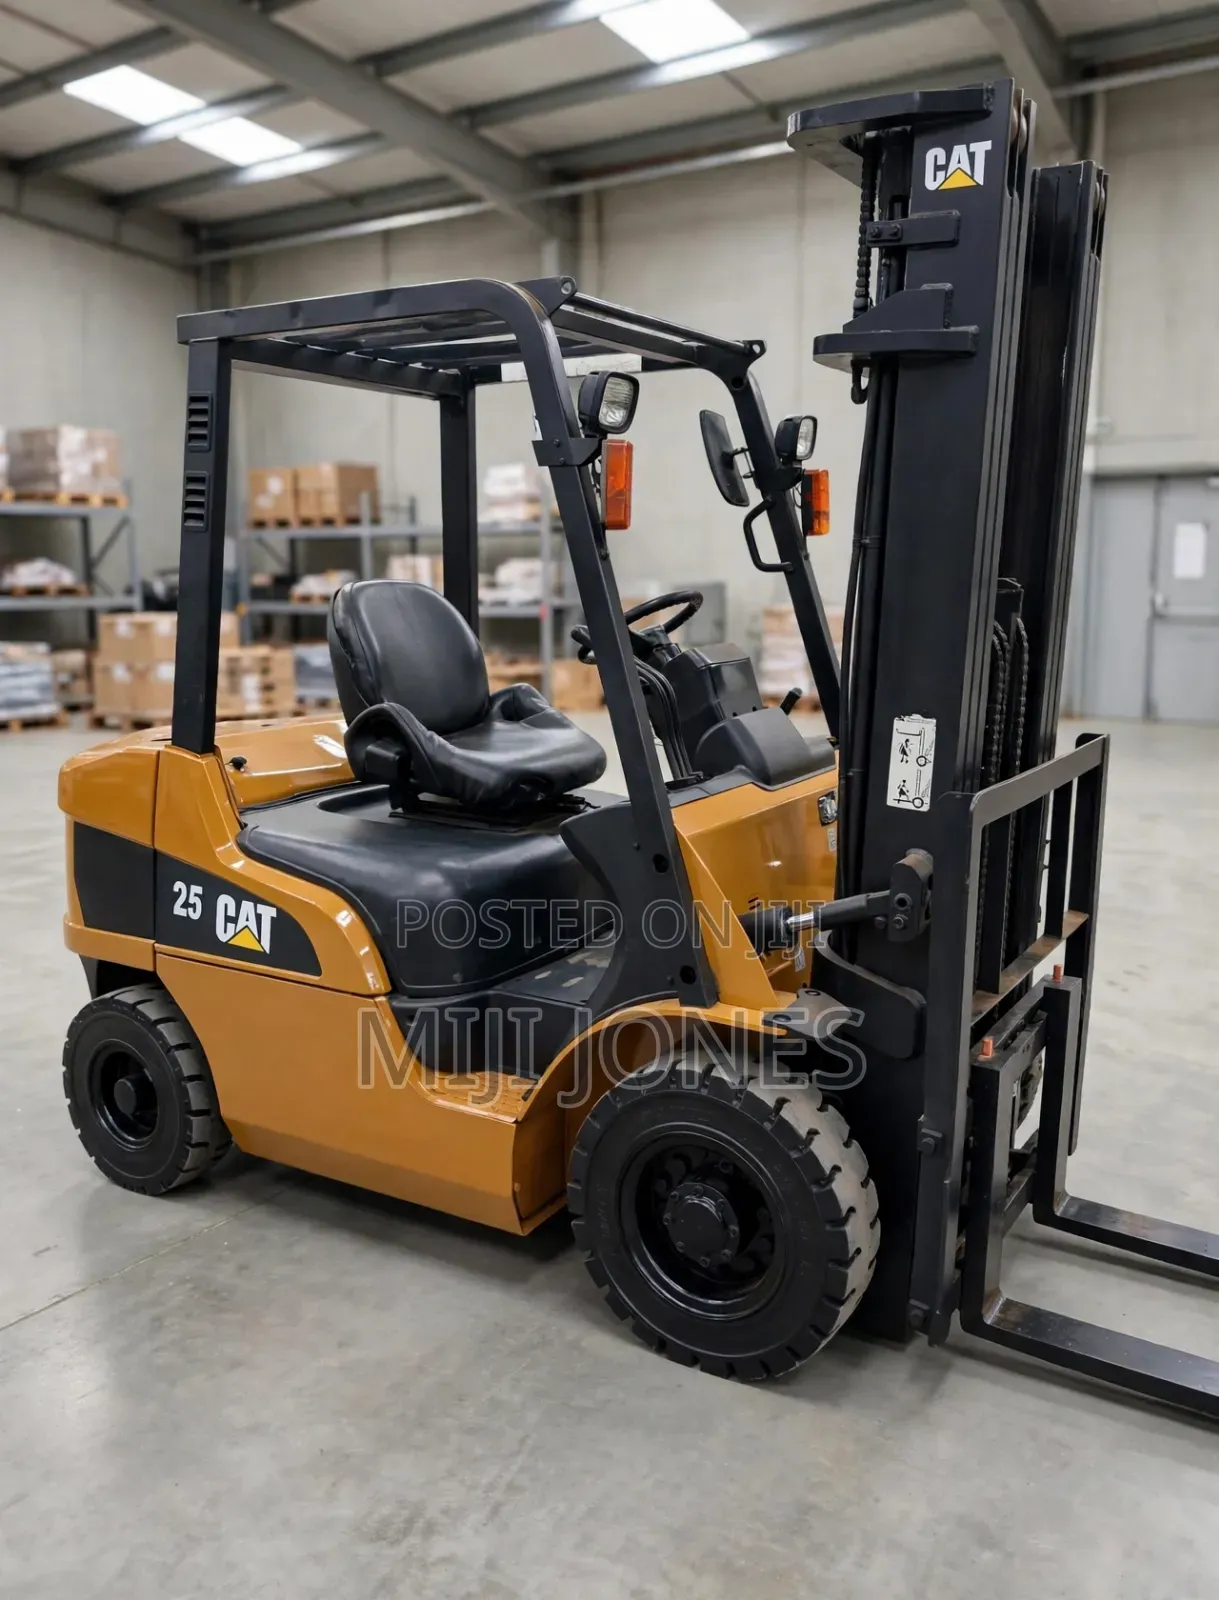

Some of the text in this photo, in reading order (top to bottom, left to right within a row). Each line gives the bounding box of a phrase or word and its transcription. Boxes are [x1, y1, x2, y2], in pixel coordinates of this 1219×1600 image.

[924, 140, 992, 191] CAT
[173, 880, 277, 955] 25 CAT
